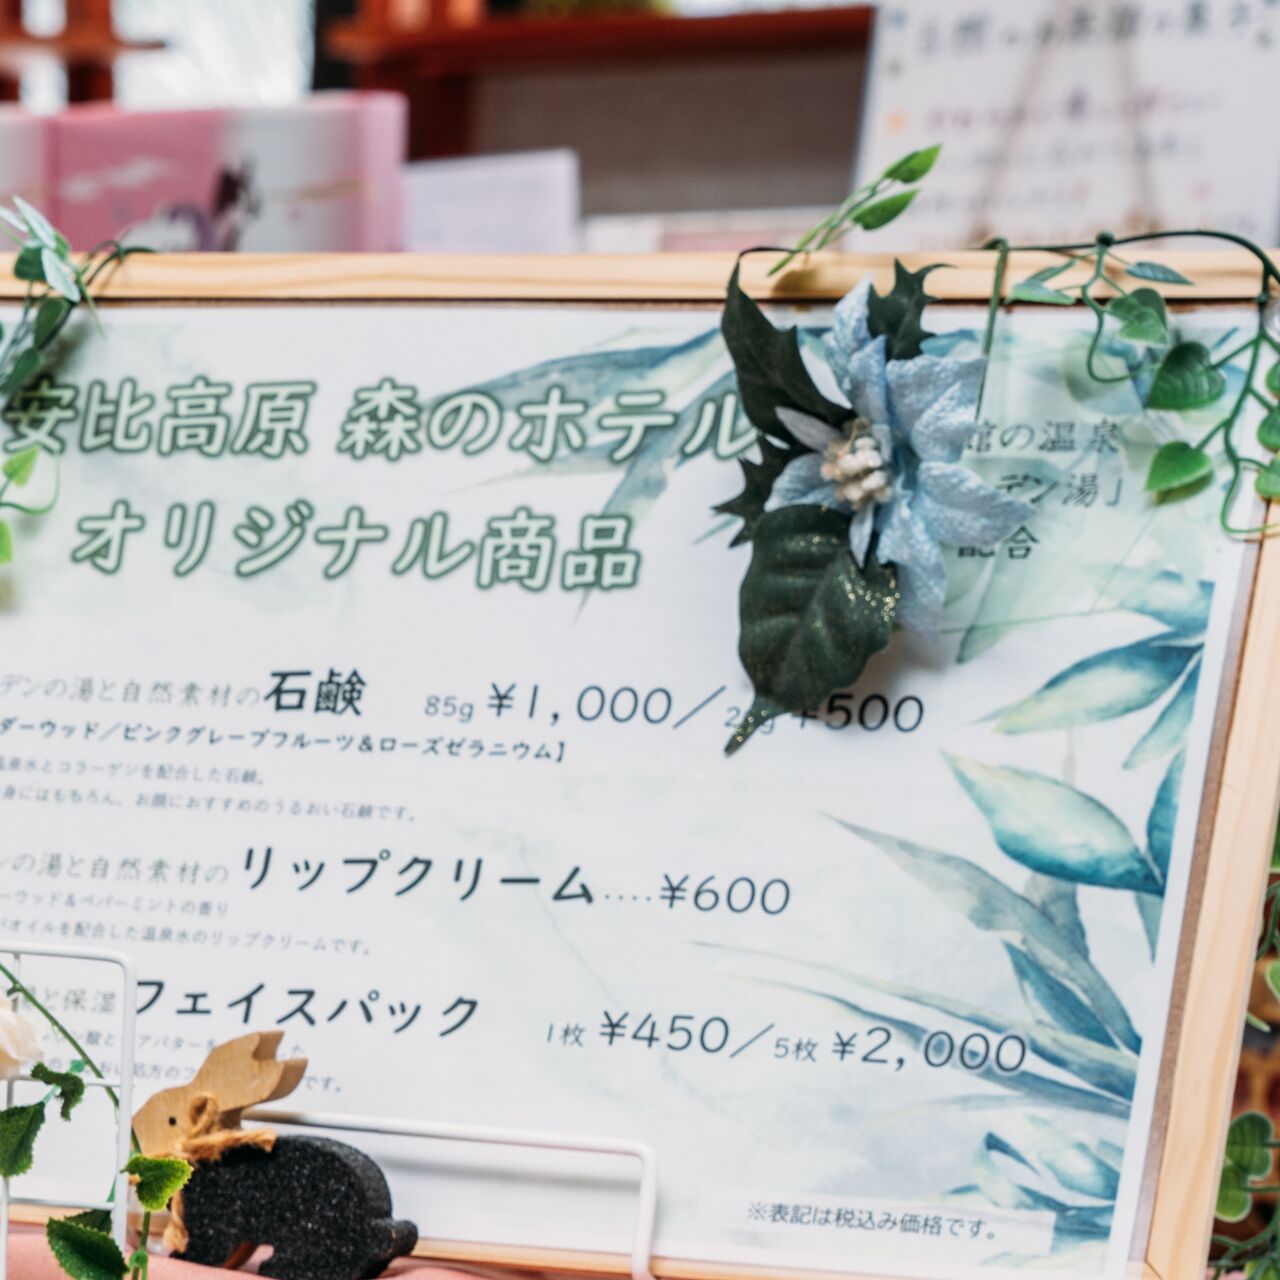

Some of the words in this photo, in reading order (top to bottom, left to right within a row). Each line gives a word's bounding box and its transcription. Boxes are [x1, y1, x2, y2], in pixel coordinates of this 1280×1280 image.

[0, 375, 317, 460] 安比高原
[336, 377, 762, 464] 森のホテル
[70, 497, 643, 593] オリジナル商品
[424, 694, 475, 723] 85g
[244, 846, 594, 904] リップクリーム
[136, 979, 483, 1039] フェイスパック
[831, 1024, 1030, 1076] ¥2,000
